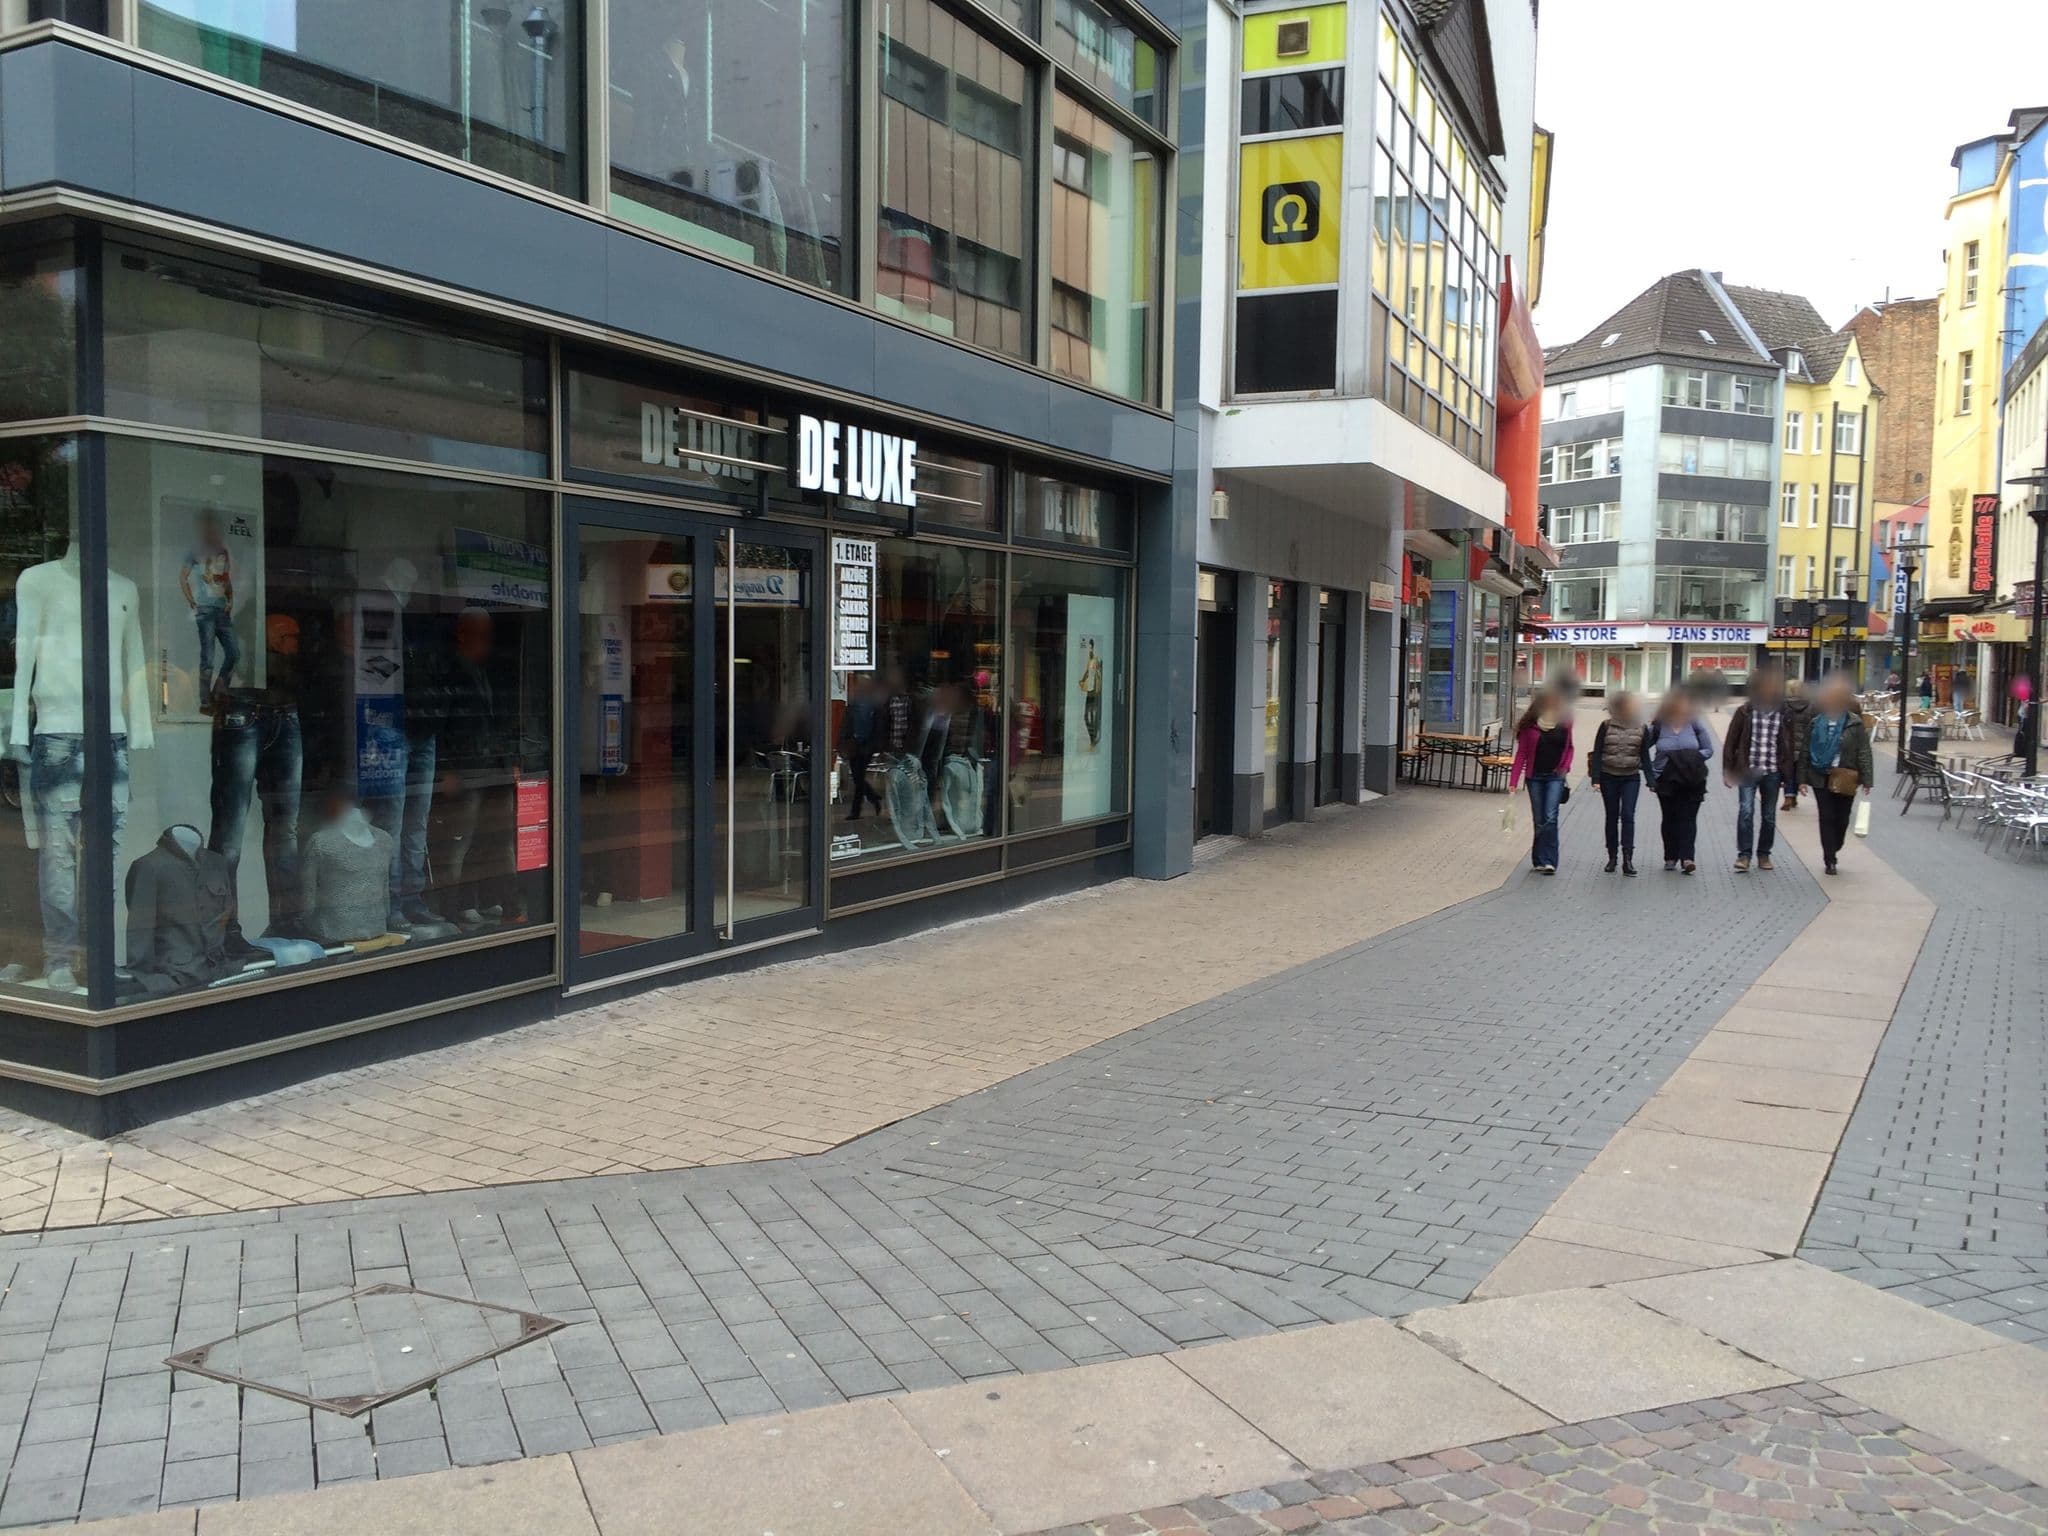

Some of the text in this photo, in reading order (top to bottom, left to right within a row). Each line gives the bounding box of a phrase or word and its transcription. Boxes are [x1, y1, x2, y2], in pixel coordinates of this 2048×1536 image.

[641, 401, 755, 481] DE LUXE
[799, 413, 917, 508] DE LUXE
[845, 543, 873, 562] ETAGE
[1973, 515, 1994, 591] Spielhalle
[1573, 627, 1617, 641] STORE
[1667, 627, 1751, 641] JEANS STORE
